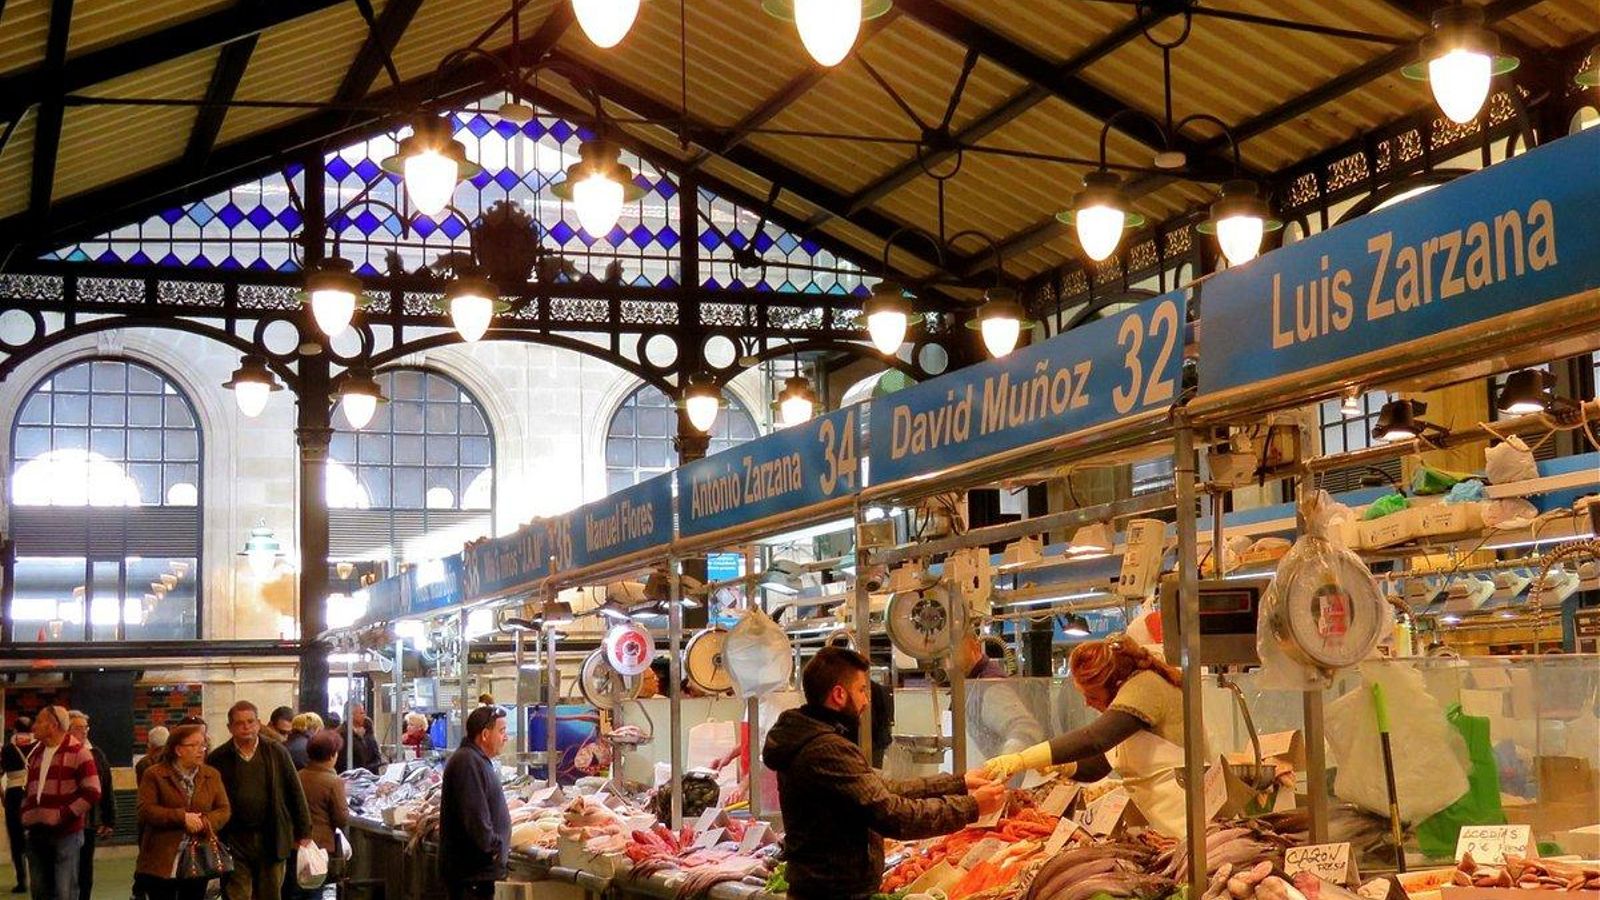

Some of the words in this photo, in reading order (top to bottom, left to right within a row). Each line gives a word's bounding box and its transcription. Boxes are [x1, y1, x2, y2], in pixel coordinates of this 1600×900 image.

[1272, 255, 1354, 349] Luis
[1367, 199, 1558, 321] Zarzana
[891, 383, 973, 460] David
[980, 359, 1092, 435] Muñoz
[1112, 300, 1179, 414] 32
[585, 504, 620, 550] Manuel
[621, 499, 655, 542] Flores
[691, 464, 741, 520] Antonio
[743, 452, 803, 504] Zarzana
[819, 410, 857, 495] 34
